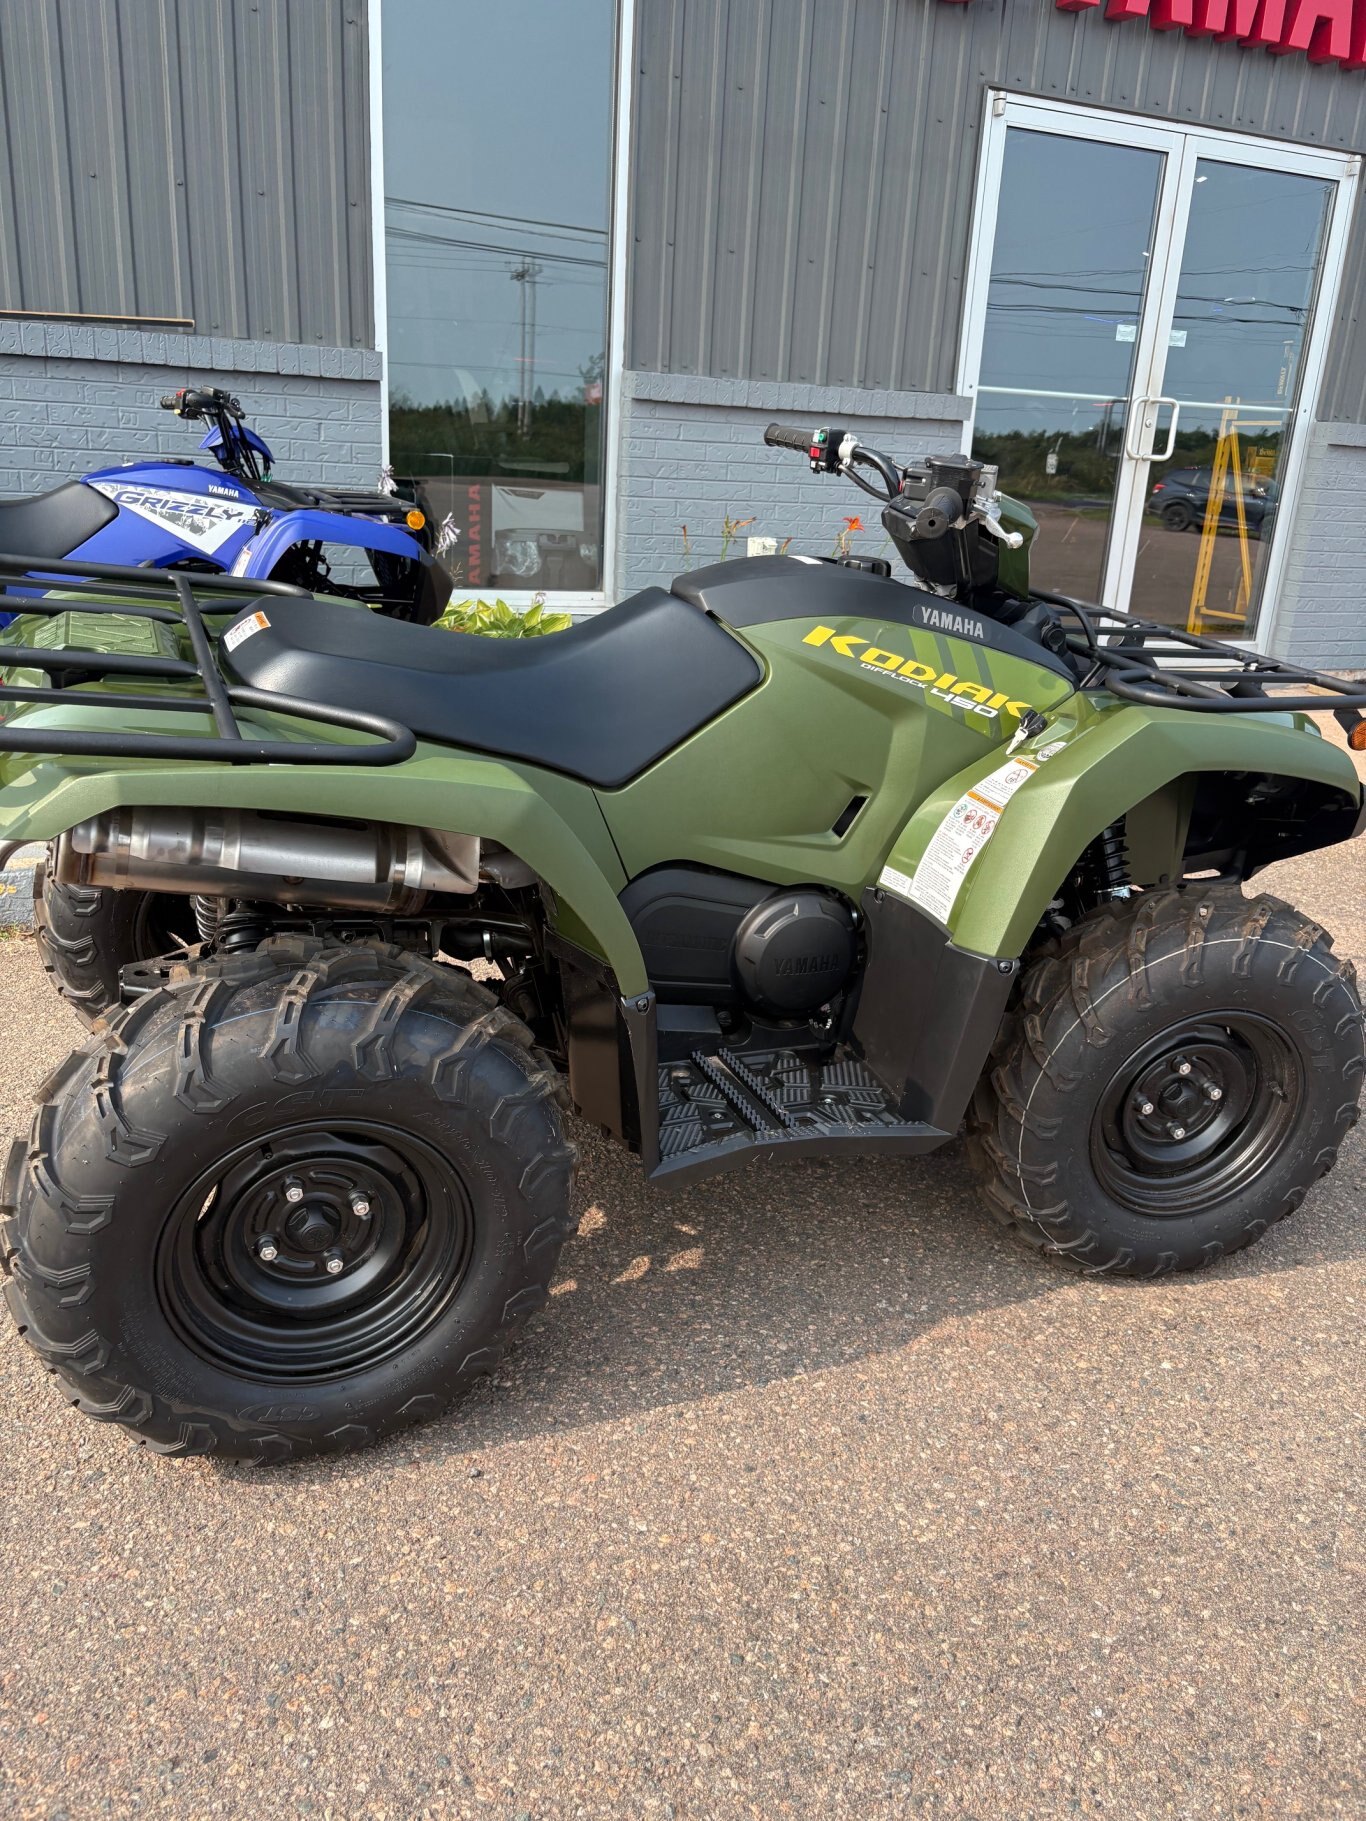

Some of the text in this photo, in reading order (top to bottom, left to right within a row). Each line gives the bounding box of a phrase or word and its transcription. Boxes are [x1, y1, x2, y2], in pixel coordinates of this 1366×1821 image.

[112, 490, 243, 521] GRIZZLY
[208, 485, 239, 498] YAMAHA
[921, 606, 984, 639] YAMAHA
[802, 625, 1033, 718] KODIAK
[860, 662, 999, 718] DIFFLOCK 450
[775, 953, 841, 978] YAMAHA
